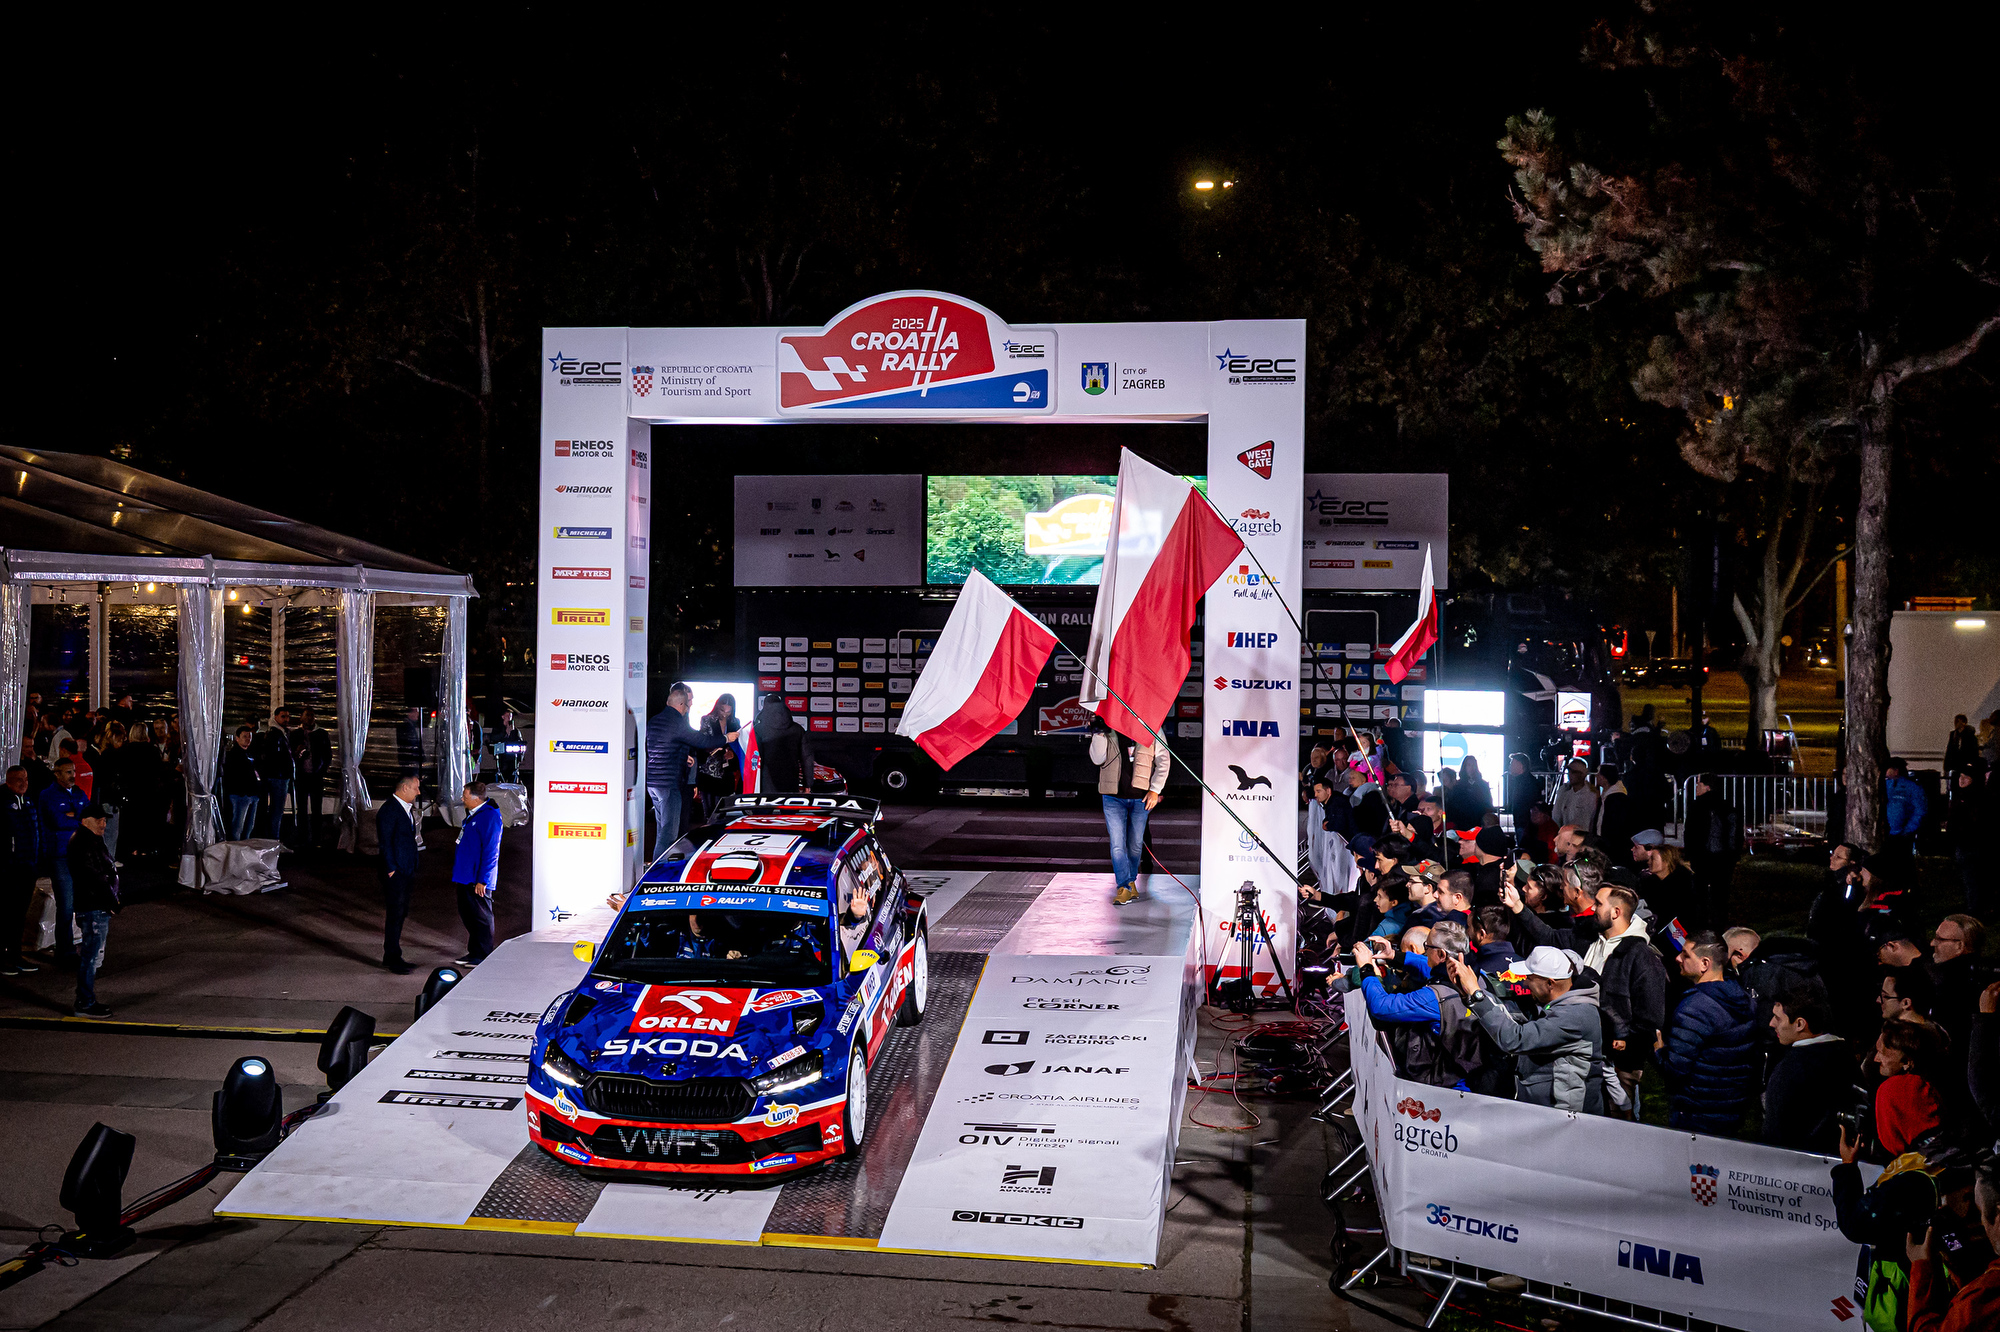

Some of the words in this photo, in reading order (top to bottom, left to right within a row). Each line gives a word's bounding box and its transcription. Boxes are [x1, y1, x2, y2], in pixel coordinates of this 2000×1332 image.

[892, 318, 924, 330] 2025
[851, 331, 960, 352] CROATIA
[880, 352, 957, 372] RALLY
[1229, 359, 1296, 373] ERC
[560, 362, 622, 375] ERC
[661, 366, 702, 374] REPUBLIC
[703, 366, 714, 374] OF
[716, 366, 753, 374] CROATIA
[661, 376, 704, 388] Ministry
[706, 376, 716, 387] of
[1122, 379, 1166, 390] ZAGREB
[661, 387, 699, 397] Tourism
[704, 387, 722, 397] and
[724, 387, 752, 399] Sport
[571, 440, 614, 450] ENEOS
[1246, 448, 1272, 460] WEST
[1248, 458, 1272, 468] GATE
[1319, 501, 1389, 516] ERC
[1229, 518, 1282, 536] Zagreb
[553, 569, 581, 577] MRF
[557, 610, 606, 623] PIRELLI
[1245, 632, 1278, 648] HEP
[568, 654, 610, 664] ENEOS
[1231, 679, 1292, 690] SUZUKI
[550, 783, 579, 791] MRF
[579, 784, 606, 792] TYRES
[553, 824, 602, 837] PIRELLI
[743, 834, 771, 846] 2
[643, 885, 714, 894] VOLKSWAGEN
[717, 885, 772, 894] FINANCIAL
[774, 887, 822, 899] SERVICES
[1514, 984, 1532, 996] Bu
[1022, 1002, 1120, 1010] CORNER
[487, 1010, 541, 1019] ENE
[639, 1016, 731, 1033] ORLEN
[1042, 1065, 1130, 1075] JANAF
[393, 1092, 510, 1108] PIRELLI
[1069, 1095, 1140, 1104] AIRLINES
[557, 1099, 574, 1114] LOTTO
[772, 1108, 794, 1122] LOTTO
[617, 1128, 721, 1157] VWFS
[958, 1134, 1014, 1146] OIV
[1019, 1136, 1073, 1144] Digitalni
[1393, 1122, 1459, 1154] agreb
[1420, 1148, 1449, 1159] CROATIA
[1728, 1170, 1783, 1189] REPUBLIC
[1784, 1181, 1800, 1192] OF
[1801, 1184, 1834, 1198] CROA
[1727, 1184, 1785, 1207] Ministry
[1788, 1195, 1803, 1207] of
[1728, 1198, 1784, 1219] Tourism
[1788, 1209, 1811, 1225] and
[1815, 1213, 1840, 1232] Spo
